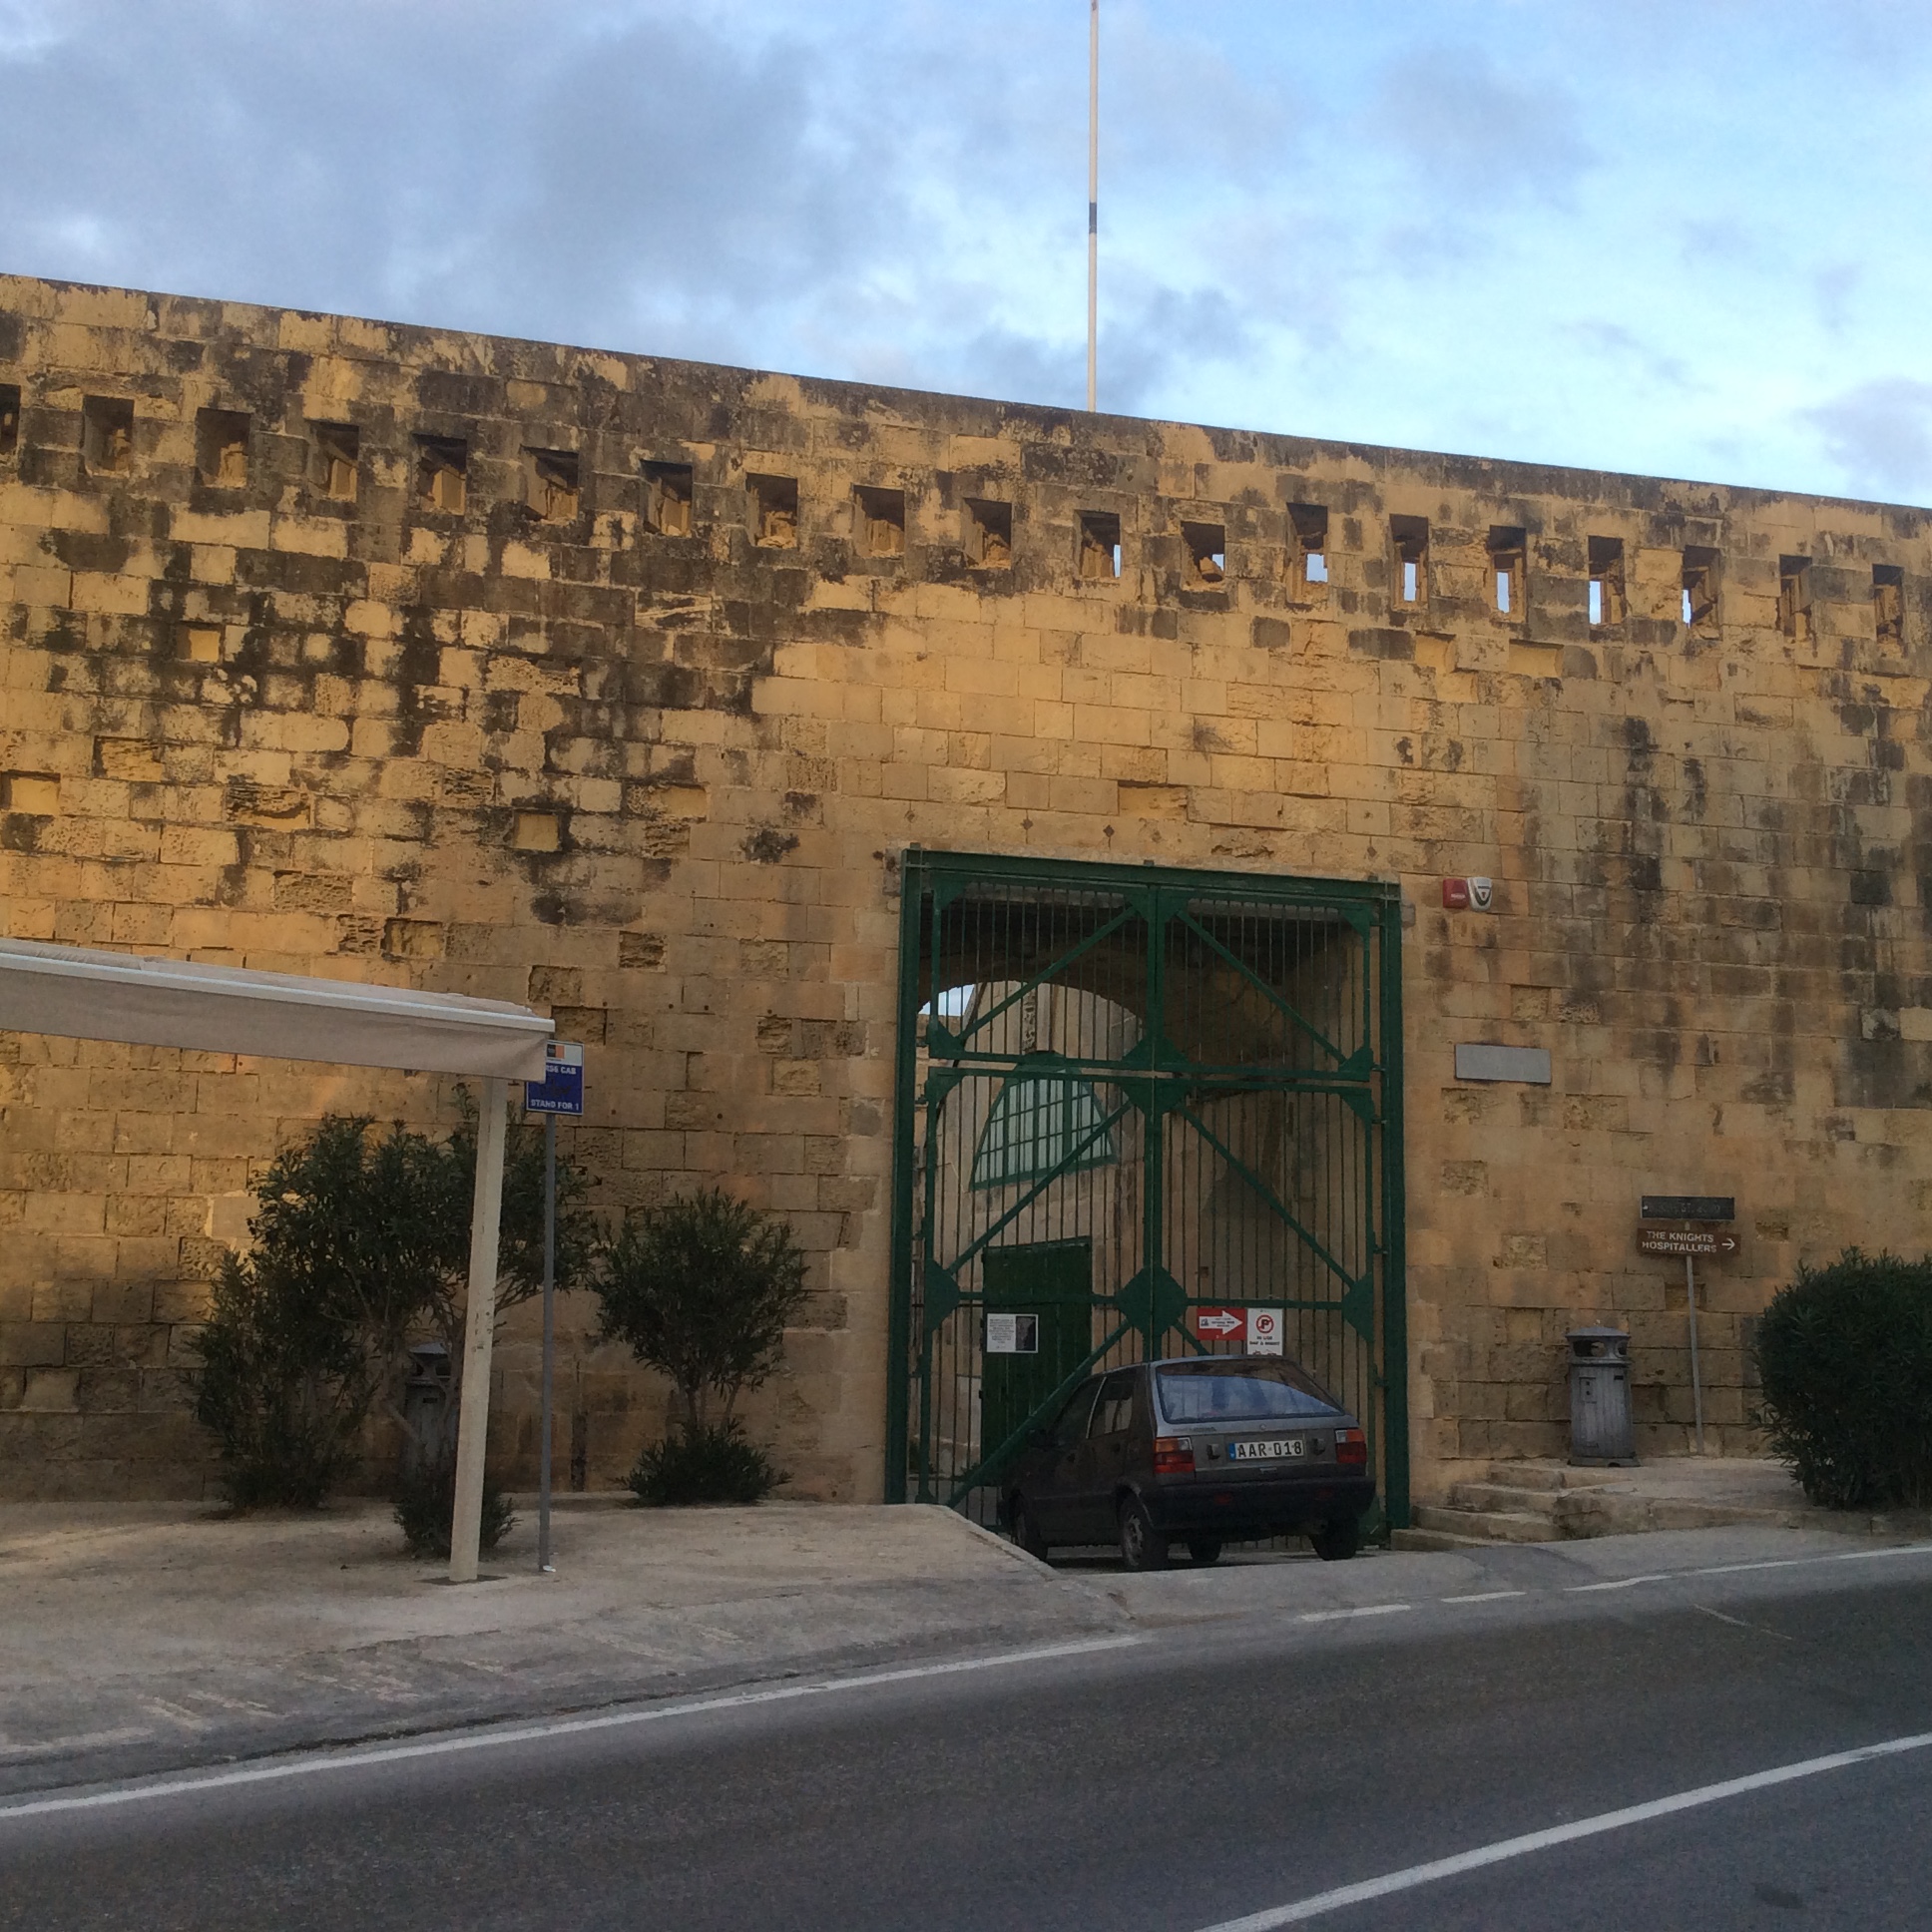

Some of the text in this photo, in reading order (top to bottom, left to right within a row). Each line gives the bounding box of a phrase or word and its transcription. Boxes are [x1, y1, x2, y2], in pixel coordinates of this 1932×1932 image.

[560, 1066, 577, 1075] CAB
[531, 1099, 556, 1108] STAND
[558, 1101, 573, 1110] FOR
[1646, 1230, 1714, 1242] THE KNIGHTS
[1642, 1241, 1717, 1253] HOSPITALLERS
[1238, 1441, 1302, 1458] AAR 018
